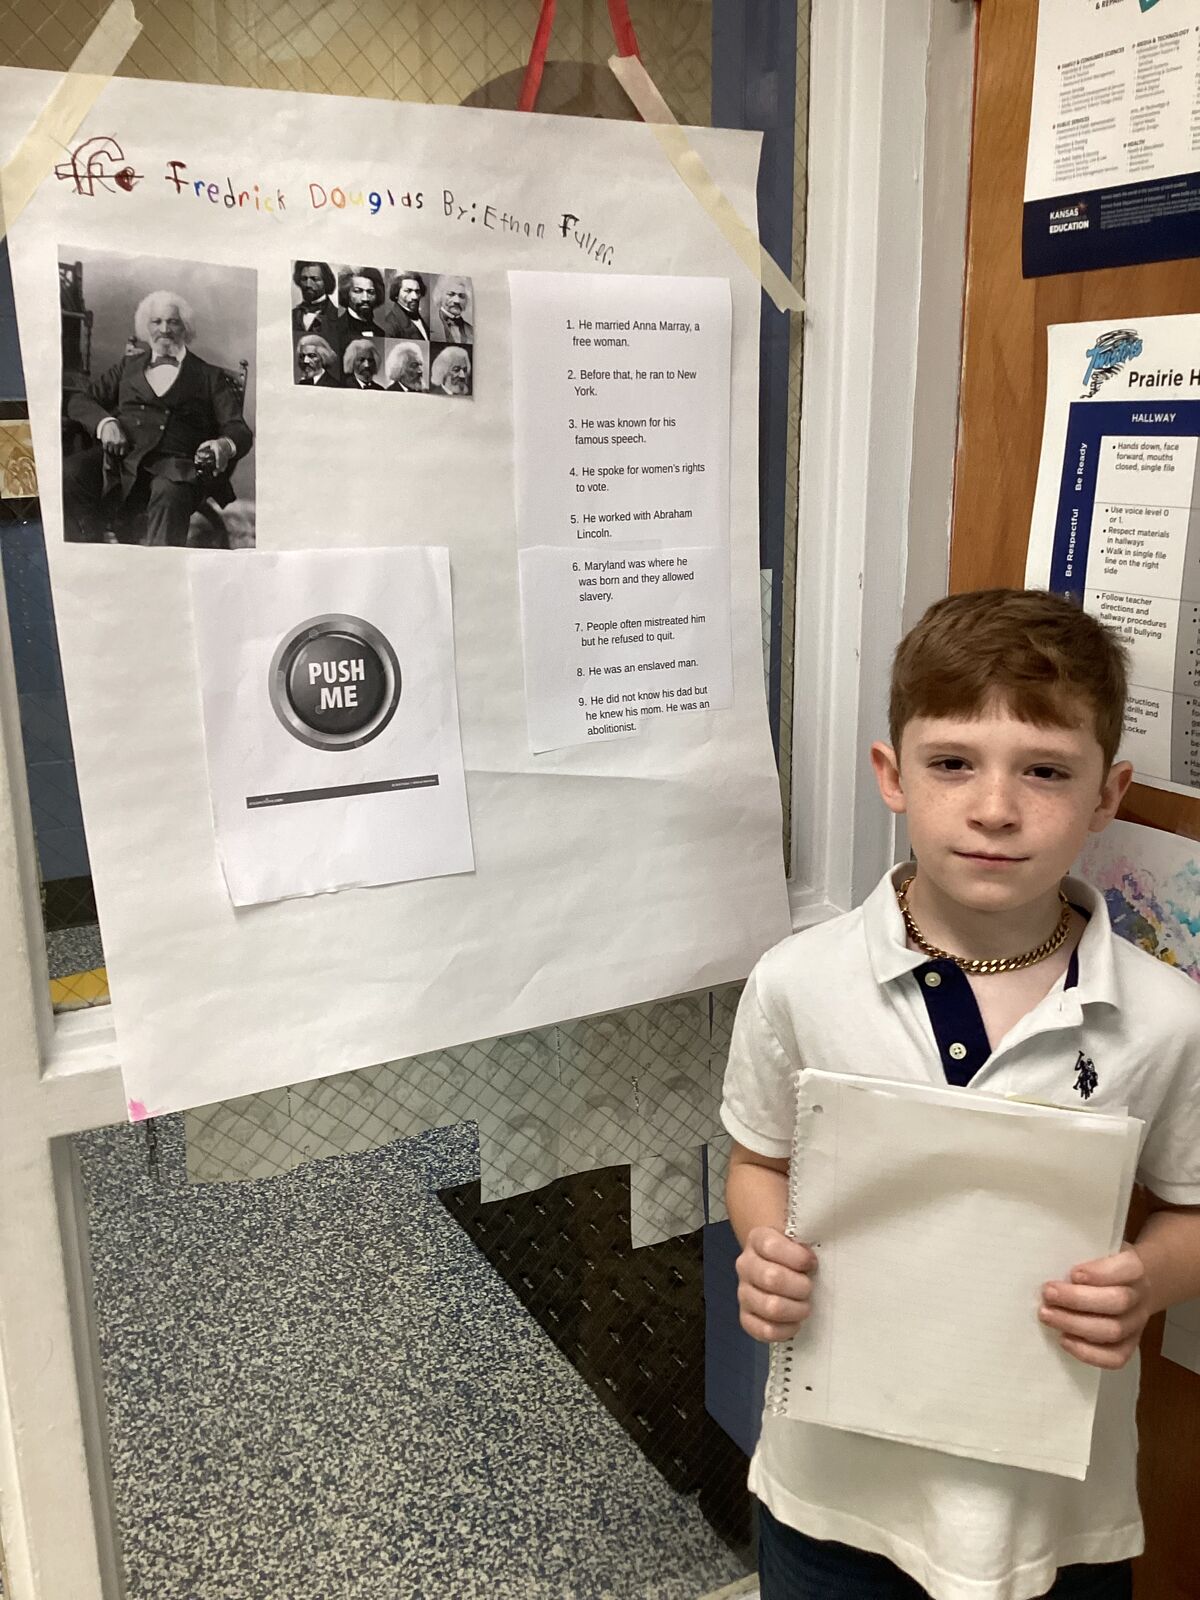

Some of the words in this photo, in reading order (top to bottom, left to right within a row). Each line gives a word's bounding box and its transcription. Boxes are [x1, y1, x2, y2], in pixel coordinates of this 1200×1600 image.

[165, 160, 286, 212] Fredrick
[1050, 208, 1078, 220] KANSAS
[1049, 220, 1089, 234] EDUCATION
[566, 320, 574, 329] 1.
[579, 320, 592, 329] He
[595, 320, 630, 330] married
[633, 321, 657, 330] Anna
[659, 321, 692, 333] Marray,
[573, 337, 591, 346] free
[594, 338, 629, 346] woman.
[568, 370, 576, 379] 2.
[580, 370, 610, 379] Before
[613, 370, 633, 380] that,
[636, 370, 646, 379] he
[667, 371, 675, 379] to
[678, 370, 696, 379] New
[1129, 369, 1183, 387] Prairie
[575, 387, 597, 396] York.
[569, 420, 577, 428] 3.
[582, 420, 594, 428] He
[618, 418, 646, 427] known
[649, 418, 660, 427] for
[663, 418, 676, 426] his
[1132, 413, 1176, 422] HALLWAY
[575, 435, 609, 444] famous
[611, 434, 646, 446] speech.
[1077, 442, 1087, 474] Ready
[569, 468, 578, 476] 4.
[583, 467, 595, 476] He
[598, 466, 624, 477] spoke
[627, 466, 639, 474] for
[641, 464, 680, 474] women's
[682, 463, 705, 474] rights
[1141, 464, 1161, 472] single
[576, 484, 585, 492] to
[588, 483, 609, 491] vote.
[1075, 478, 1082, 491] Be
[571, 515, 579, 524] 5.
[583, 514, 596, 523] He
[599, 512, 631, 522] worked
[633, 512, 651, 521] with
[654, 510, 692, 519] Abraham
[1145, 508, 1161, 516] level
[577, 529, 612, 539] Lincoln.
[1067, 509, 1079, 561] Respectful
[1109, 527, 1135, 535] Respect
[1138, 530, 1169, 538] materials
[1115, 538, 1144, 547] hallways
[1133, 550, 1153, 559] single
[1156, 551, 1166, 559] file
[573, 563, 581, 571] 6.
[585, 561, 625, 572] Maryland
[648, 558, 674, 567] where
[677, 557, 687, 566] he
[1142, 561, 1159, 569] right
[1066, 565, 1072, 577] Be
[579, 578, 597, 586] was
[600, 576, 619, 585] born
[622, 575, 638, 584] and
[641, 574, 659, 584] they
[662, 572, 694, 582] allowed
[579, 592, 613, 603] slavery.
[1101, 593, 1124, 602] Follow
[1126, 597, 1152, 605] teacher
[1101, 603, 1134, 613] directions
[575, 623, 583, 631] 7.
[587, 621, 617, 633] People
[620, 620, 642, 629] often
[644, 616, 688, 627] mistreated
[691, 615, 705, 623] him
[1100, 612, 1125, 622] hallway
[1127, 617, 1167, 628] procedures
[582, 638, 595, 646] but
[598, 636, 609, 645] he
[612, 634, 644, 644] refused
[657, 632, 675, 642] quit.
[1134, 628, 1161, 639] bullying
[308, 659, 365, 685] PUSH
[577, 668, 585, 676] 8.
[589, 667, 601, 676] He
[604, 667, 621, 675] was
[638, 660, 675, 671] enslaved
[678, 659, 698, 668] man.
[320, 685, 358, 710] ME
[579, 697, 587, 706] 9.
[591, 696, 603, 705] He
[606, 695, 619, 703] did
[622, 694, 635, 702] not
[638, 691, 660, 701] know
[662, 690, 674, 699] his
[677, 688, 692, 697] dad
[695, 686, 708, 696] but
[586, 712, 597, 720] he
[600, 710, 623, 719] knew
[626, 707, 638, 717] his
[641, 706, 663, 715] mom.
[666, 704, 678, 712] He
[700, 700, 709, 708] an
[1127, 706, 1143, 714] drills
[588, 722, 636, 735] abolitionist.
